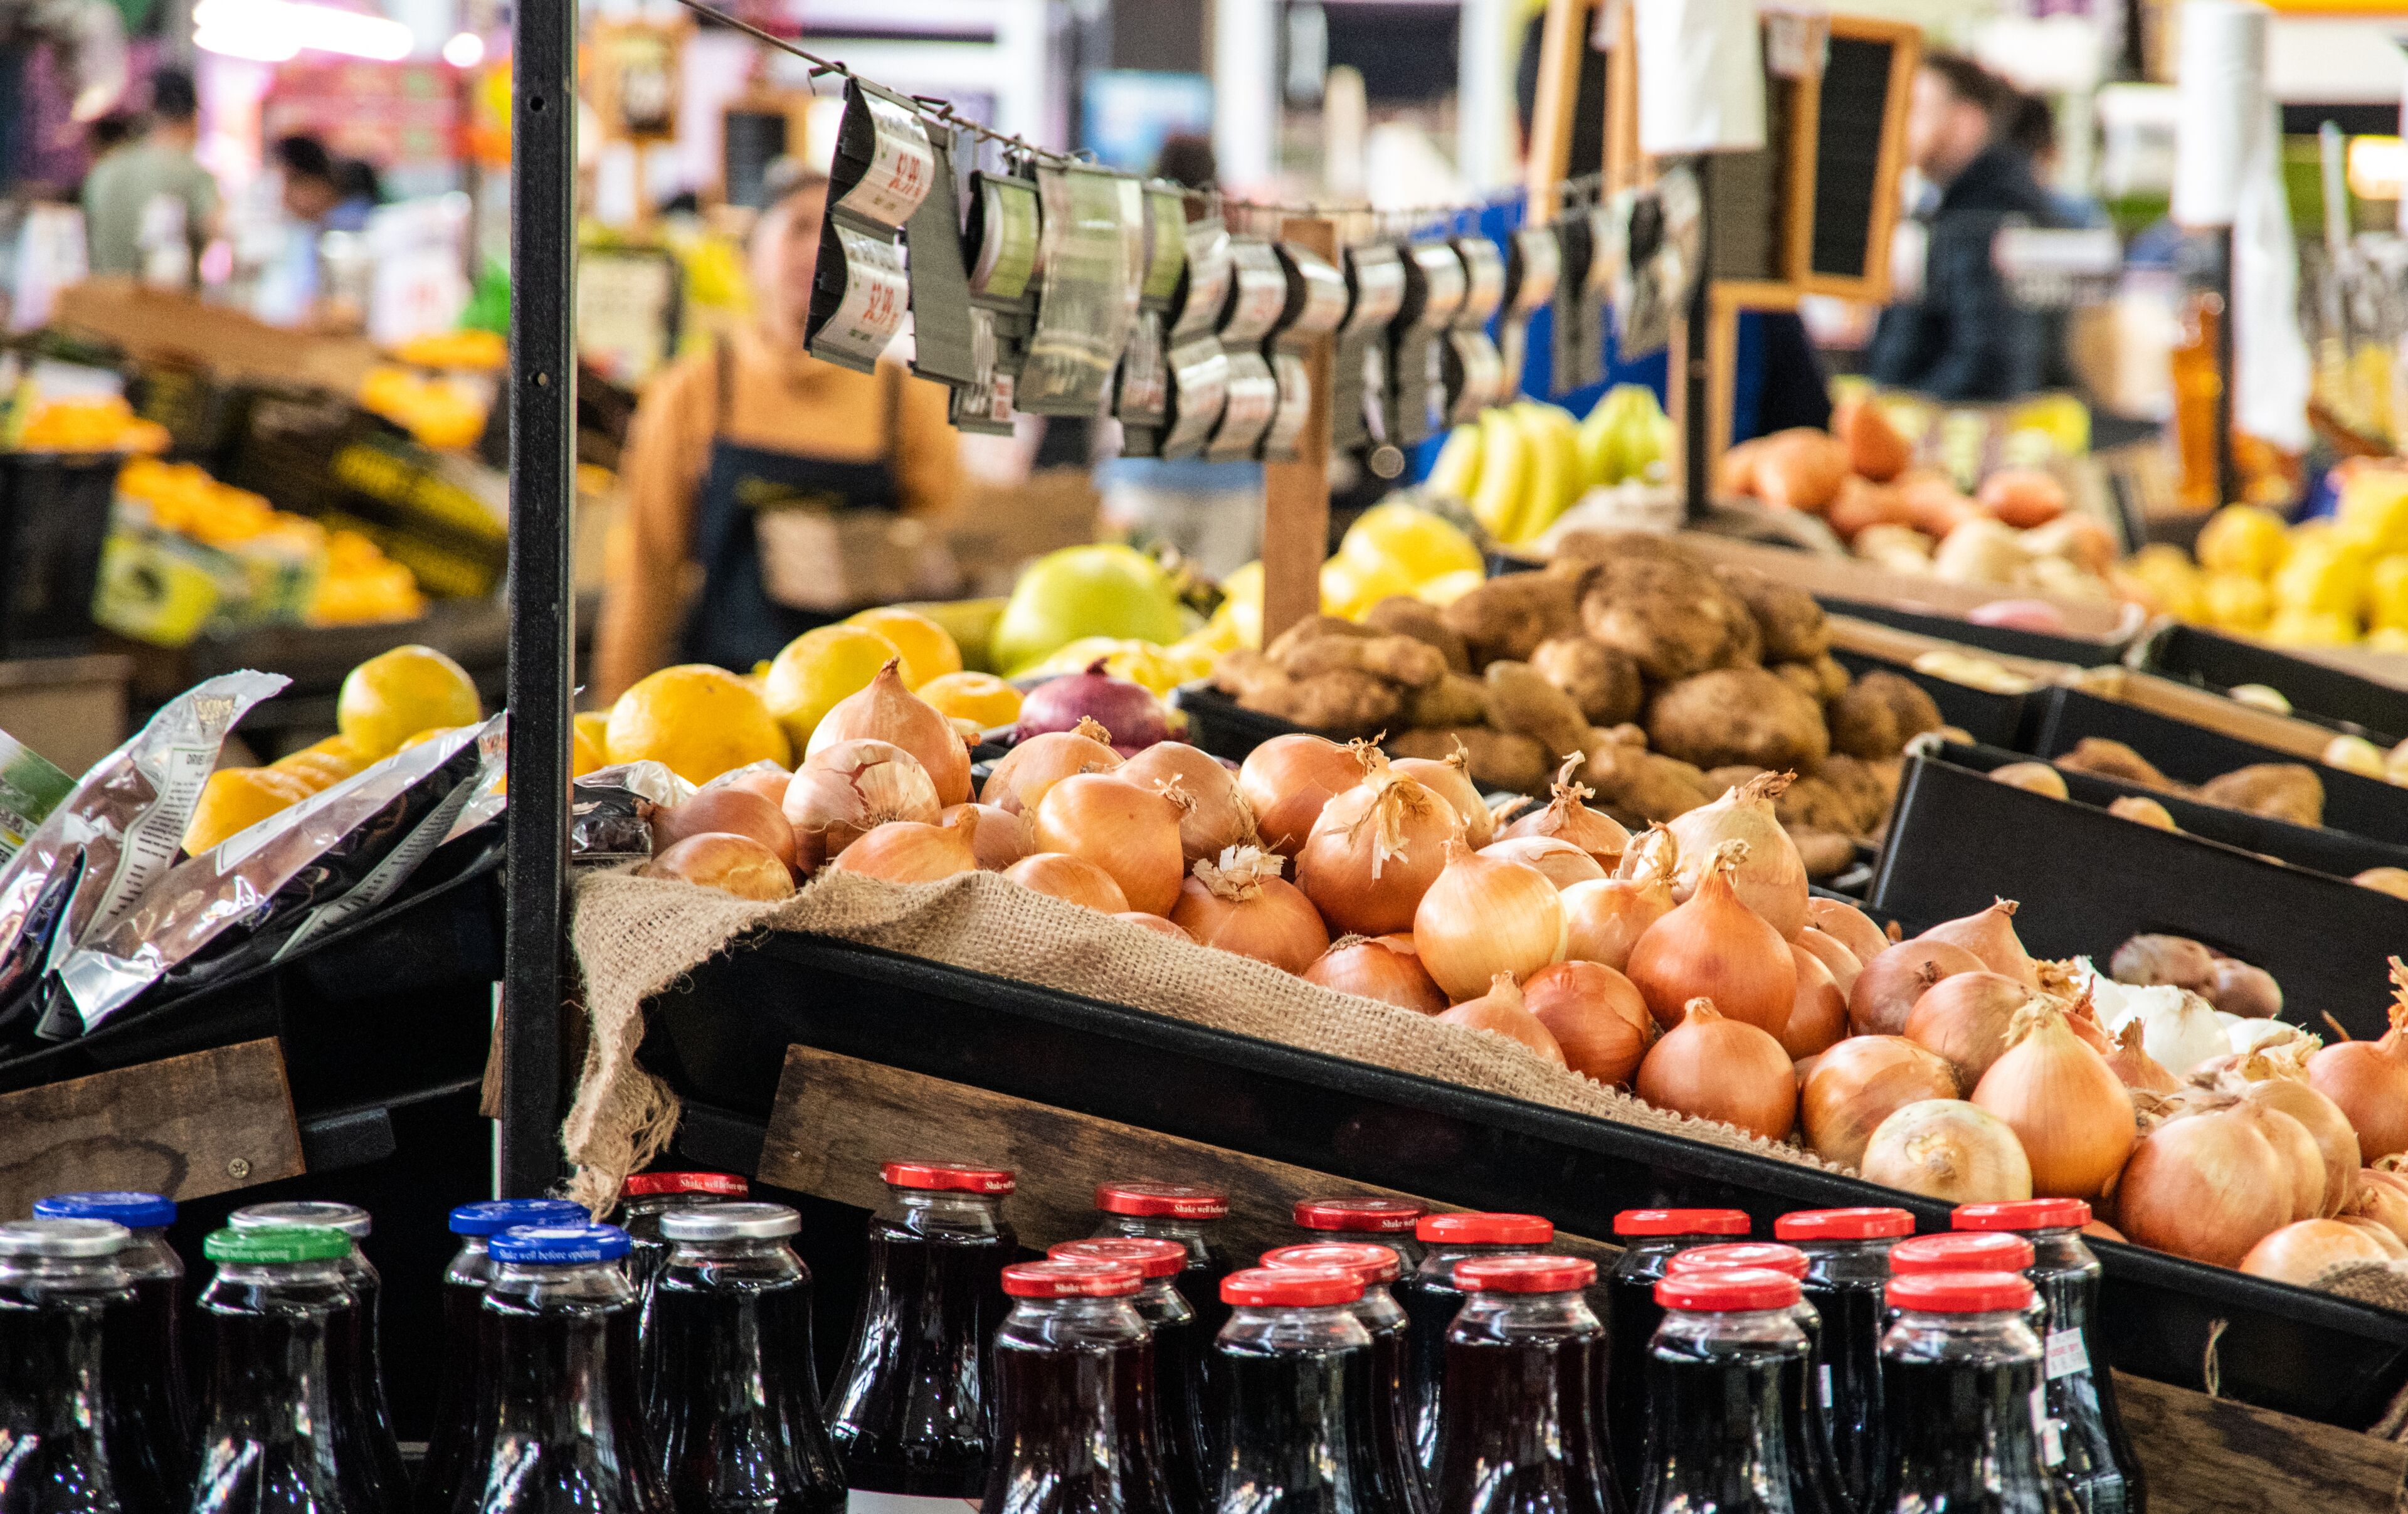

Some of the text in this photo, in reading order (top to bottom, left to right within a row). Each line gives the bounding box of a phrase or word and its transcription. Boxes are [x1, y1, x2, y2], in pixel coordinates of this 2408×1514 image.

[680, 1179, 702, 1188] Shake
[986, 1181, 1003, 1190] Shake
[1175, 1204, 1196, 1214] Shake
[1198, 1205, 1210, 1214] well
[1382, 1219, 1403, 1228] Shake
[499, 1248, 601, 1262] Shake well before opening
[1055, 1283, 1080, 1293] Shake
